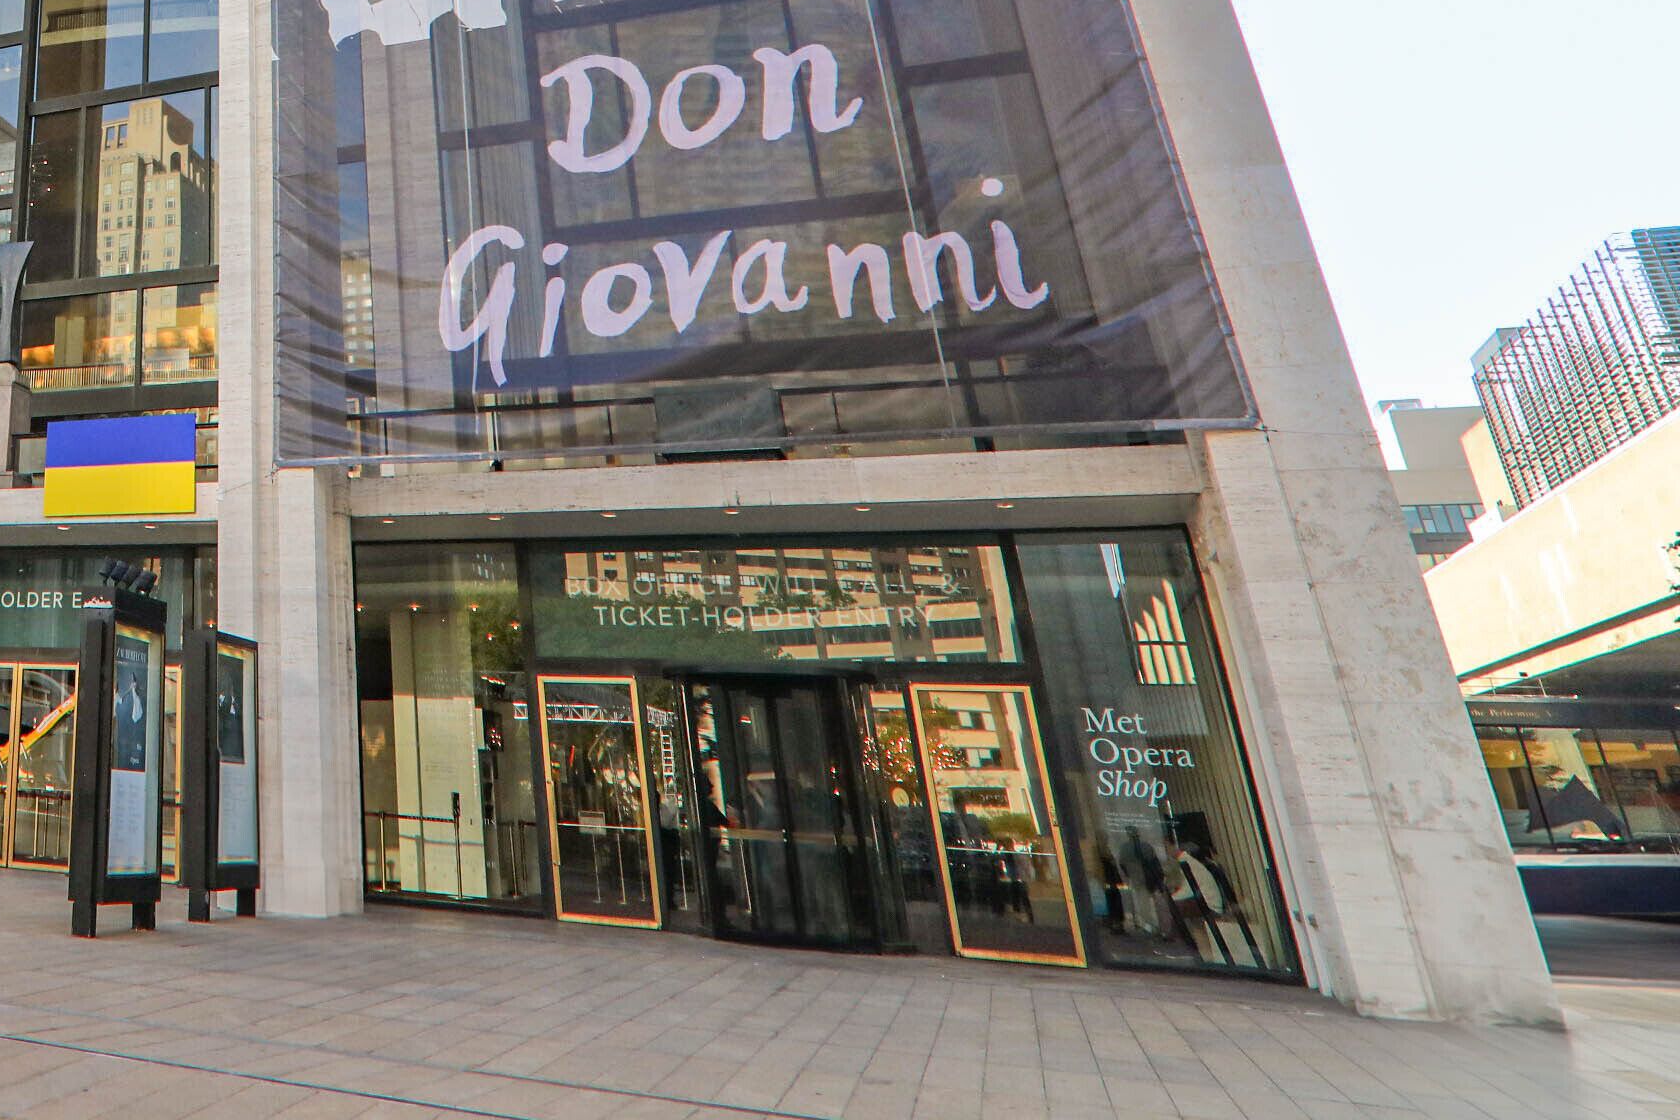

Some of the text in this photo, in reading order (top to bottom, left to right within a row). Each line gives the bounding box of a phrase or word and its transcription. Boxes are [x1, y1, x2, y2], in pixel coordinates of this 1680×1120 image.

[540, 42, 864, 174] Don
[439, 177, 1048, 388] Giovanni
[566, 576, 622, 596] BOX
[593, 605, 933, 628] TICKET-HOLDER ENTRY
[1080, 707, 1147, 734] Met
[1089, 738, 1195, 774] Opera
[1097, 769, 1167, 807] Shop
